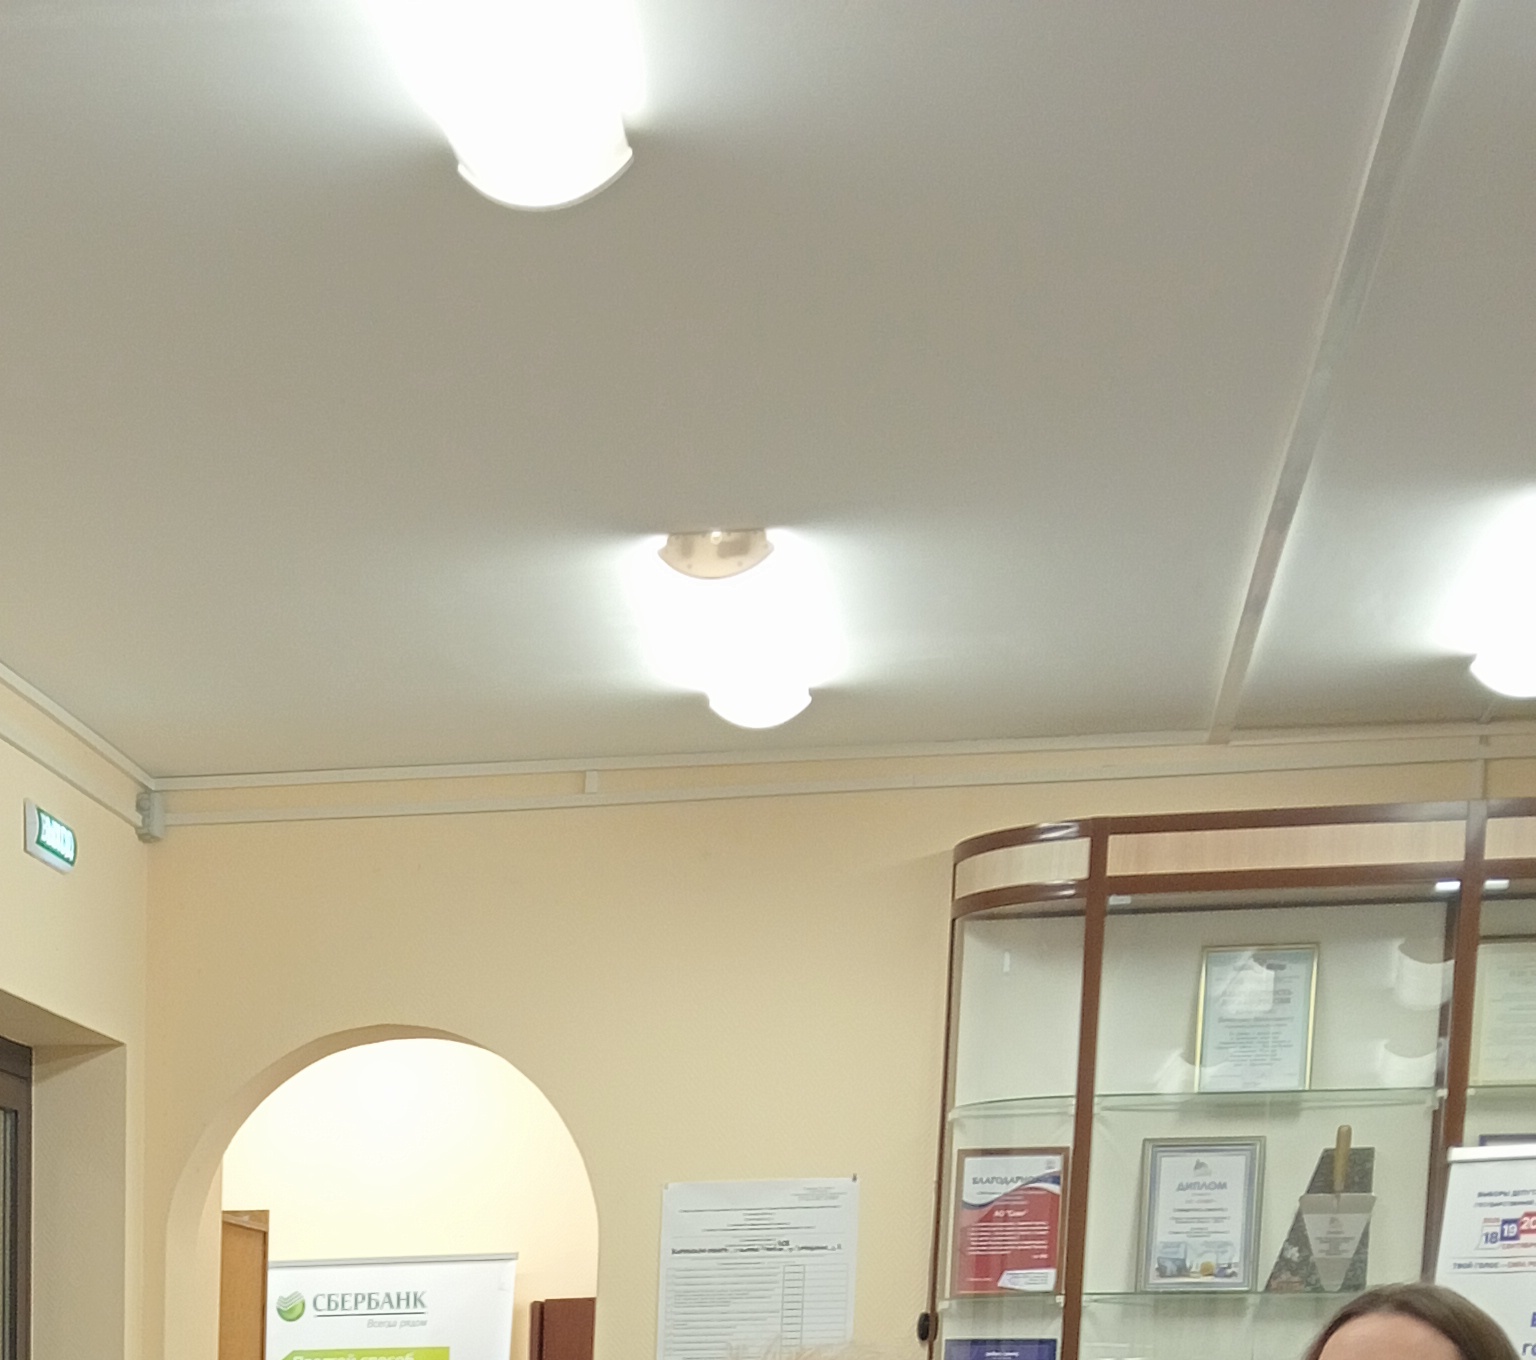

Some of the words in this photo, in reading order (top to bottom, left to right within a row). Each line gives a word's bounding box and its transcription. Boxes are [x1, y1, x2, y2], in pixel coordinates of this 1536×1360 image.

[1176, 1181, 1228, 1192] ДИПЛОМ
[1483, 1232, 1499, 1244] 18
[1502, 1224, 1518, 1237] 19
[1520, 1216, 1536, 1230] 20
[313, 1290, 428, 1312] СБЕРБАНК
